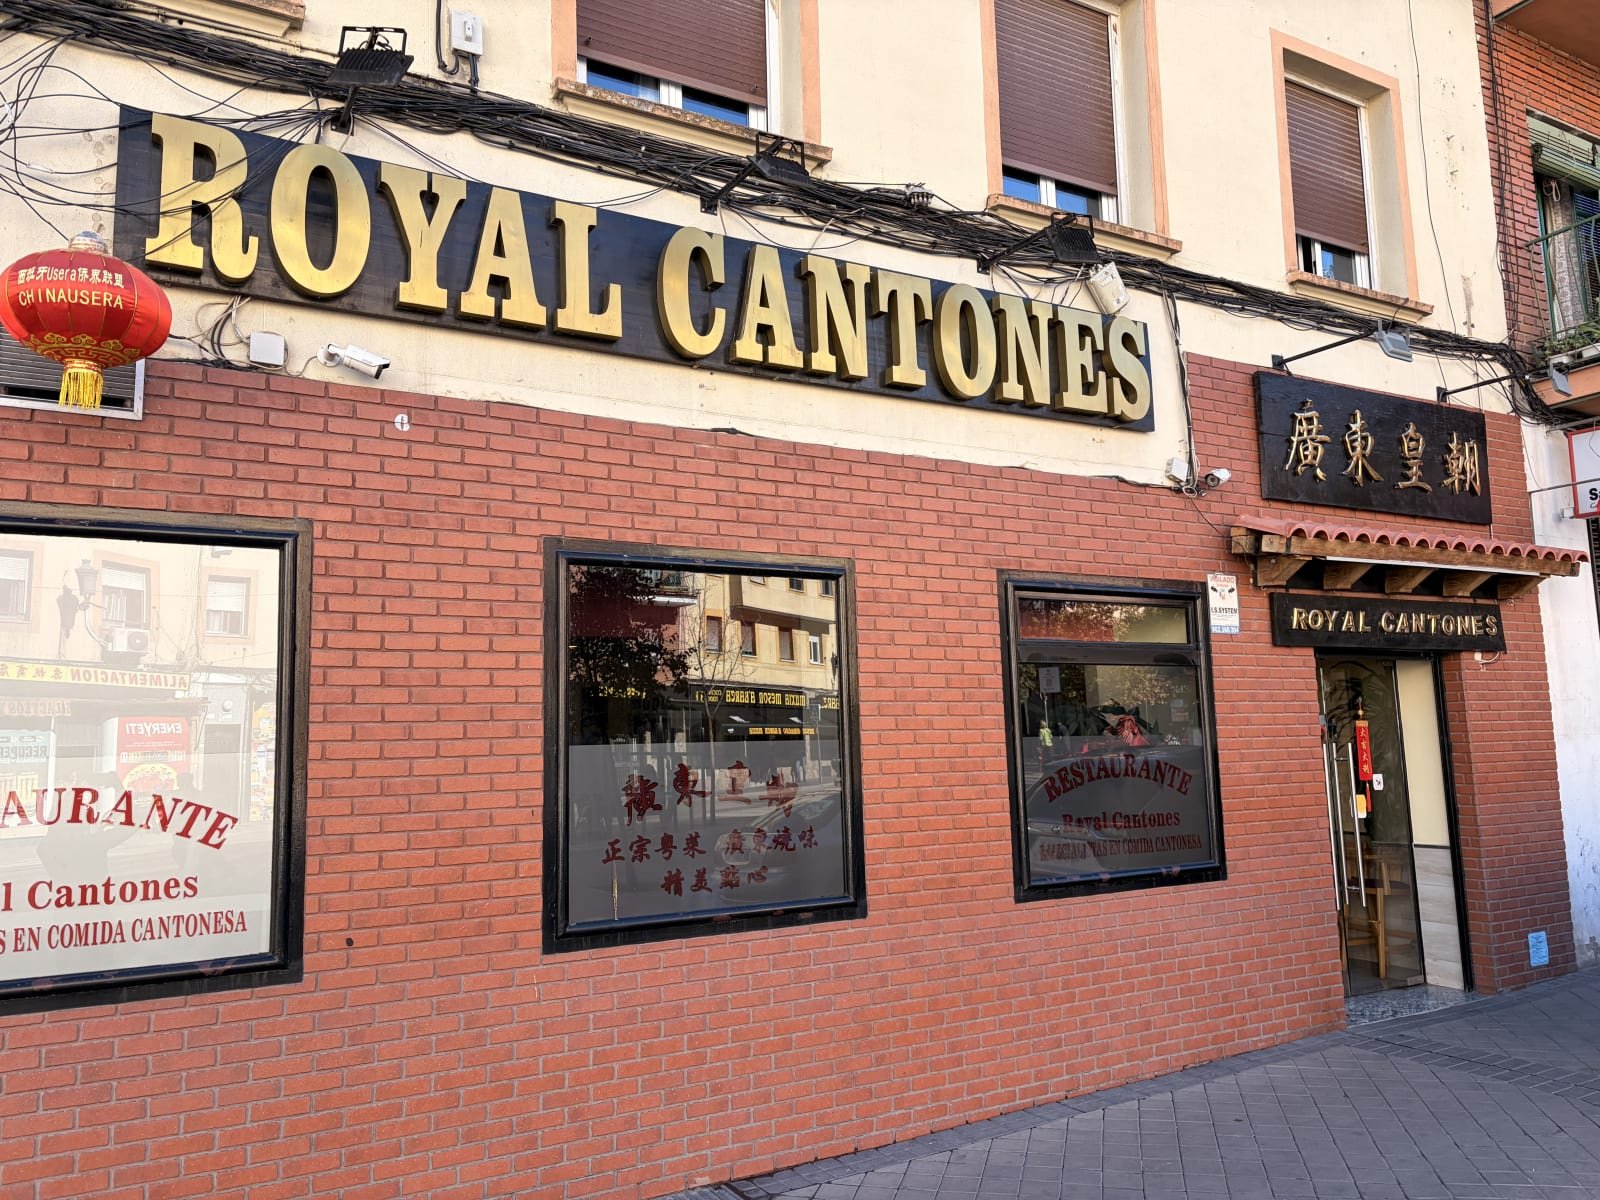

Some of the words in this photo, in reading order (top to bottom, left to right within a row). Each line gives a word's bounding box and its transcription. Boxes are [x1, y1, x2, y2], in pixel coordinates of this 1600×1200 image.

[145, 112, 623, 341] ROYAL
[656, 226, 1152, 422] CANTONES
[18, 288, 124, 309] CHINAUSERA
[1283, 398, 1482, 497] 廣東皇朝
[1589, 487, 1600, 501] S
[1291, 607, 1372, 633] ROYAL
[1380, 609, 1499, 636] CANTONES
[1042, 753, 1193, 803] RESTAURANTE
[0, 787, 239, 850] AURANTE
[1062, 811, 1107, 836] Royal
[1112, 810, 1181, 830] Cantones
[1122, 836, 1154, 855] COMIDA
[1155, 834, 1202, 852] CANTONESA
[27, 875, 199, 910] Cantones
[13, 926, 42, 953] EN
[47, 919, 126, 950] COMIDA
[131, 910, 248, 943] CANTONESA
